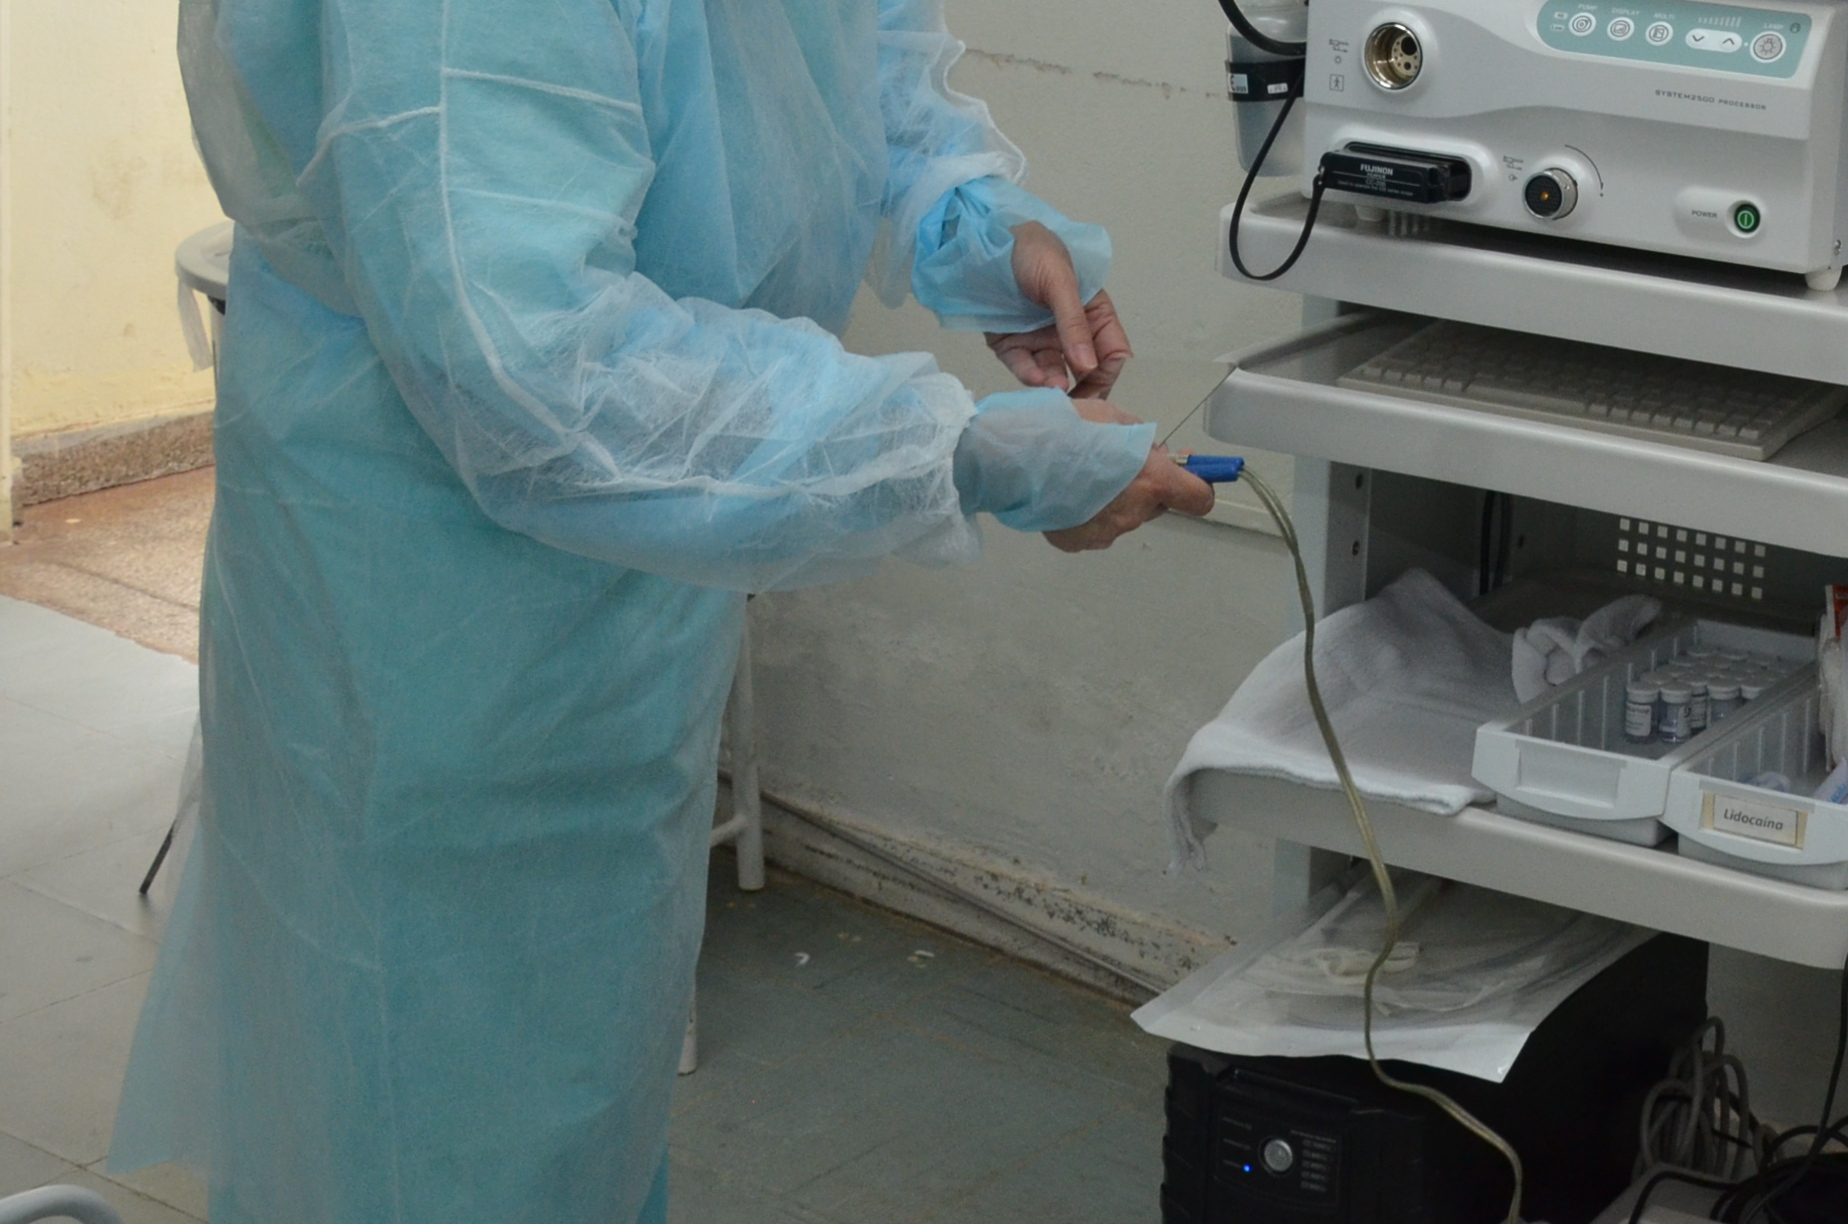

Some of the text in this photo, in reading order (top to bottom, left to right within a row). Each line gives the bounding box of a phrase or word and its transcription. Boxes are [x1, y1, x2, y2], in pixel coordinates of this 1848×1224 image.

[1654, 89, 1767, 110] SYSTEM2500 PROCESSOR
[1360, 163, 1394, 175] FUJINON
[1691, 210, 1718, 218] POWER
[1723, 808, 1784, 830] Lidocaína
